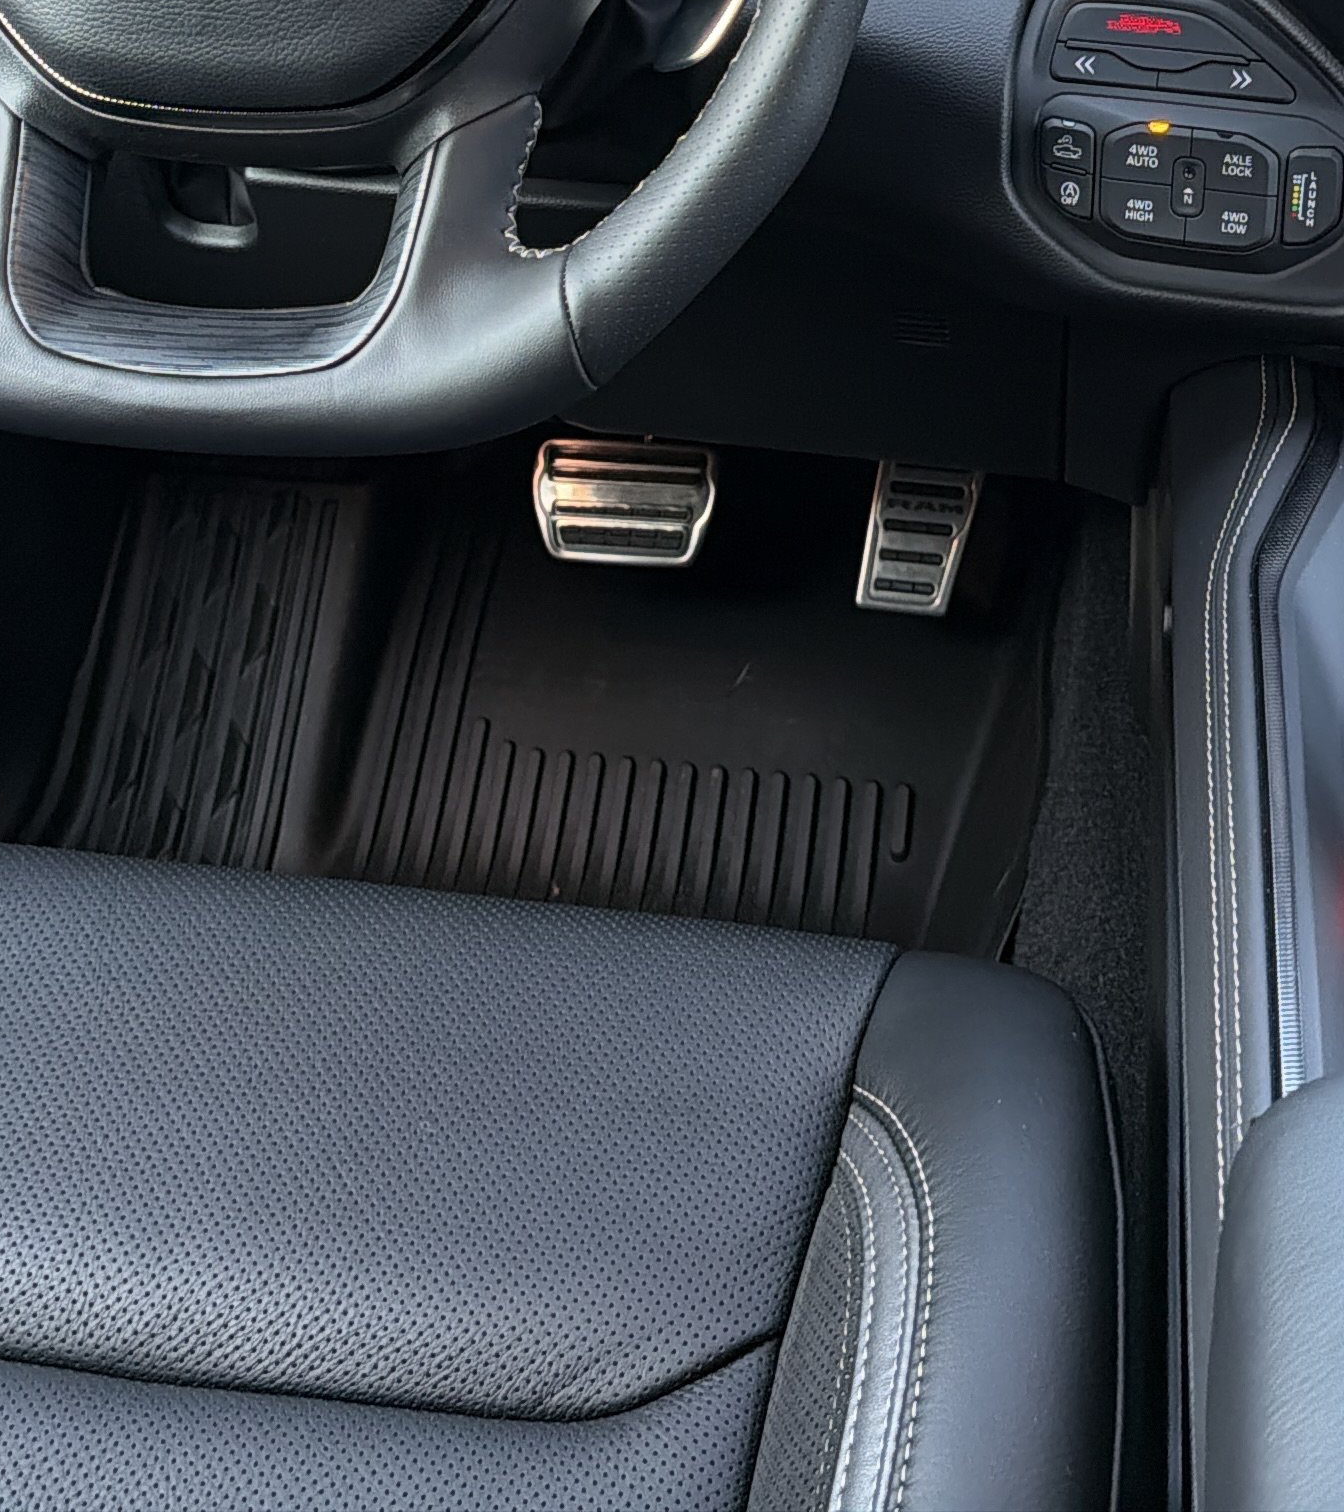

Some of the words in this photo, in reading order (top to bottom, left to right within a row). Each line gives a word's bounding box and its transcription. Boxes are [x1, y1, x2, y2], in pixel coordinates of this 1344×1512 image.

[1128, 144, 1158, 156] 4WD
[1125, 155, 1159, 168] AUTO
[1223, 153, 1253, 166] AXLE
[1221, 165, 1253, 178] LOCK
[1126, 199, 1153, 210] 4WD
[1183, 194, 1193, 204] N
[1305, 171, 1317, 227] LAUNCH
[1124, 211, 1154, 222] HIGH
[1221, 211, 1248, 223] 4WD
[1221, 222, 1247, 235] LOW
